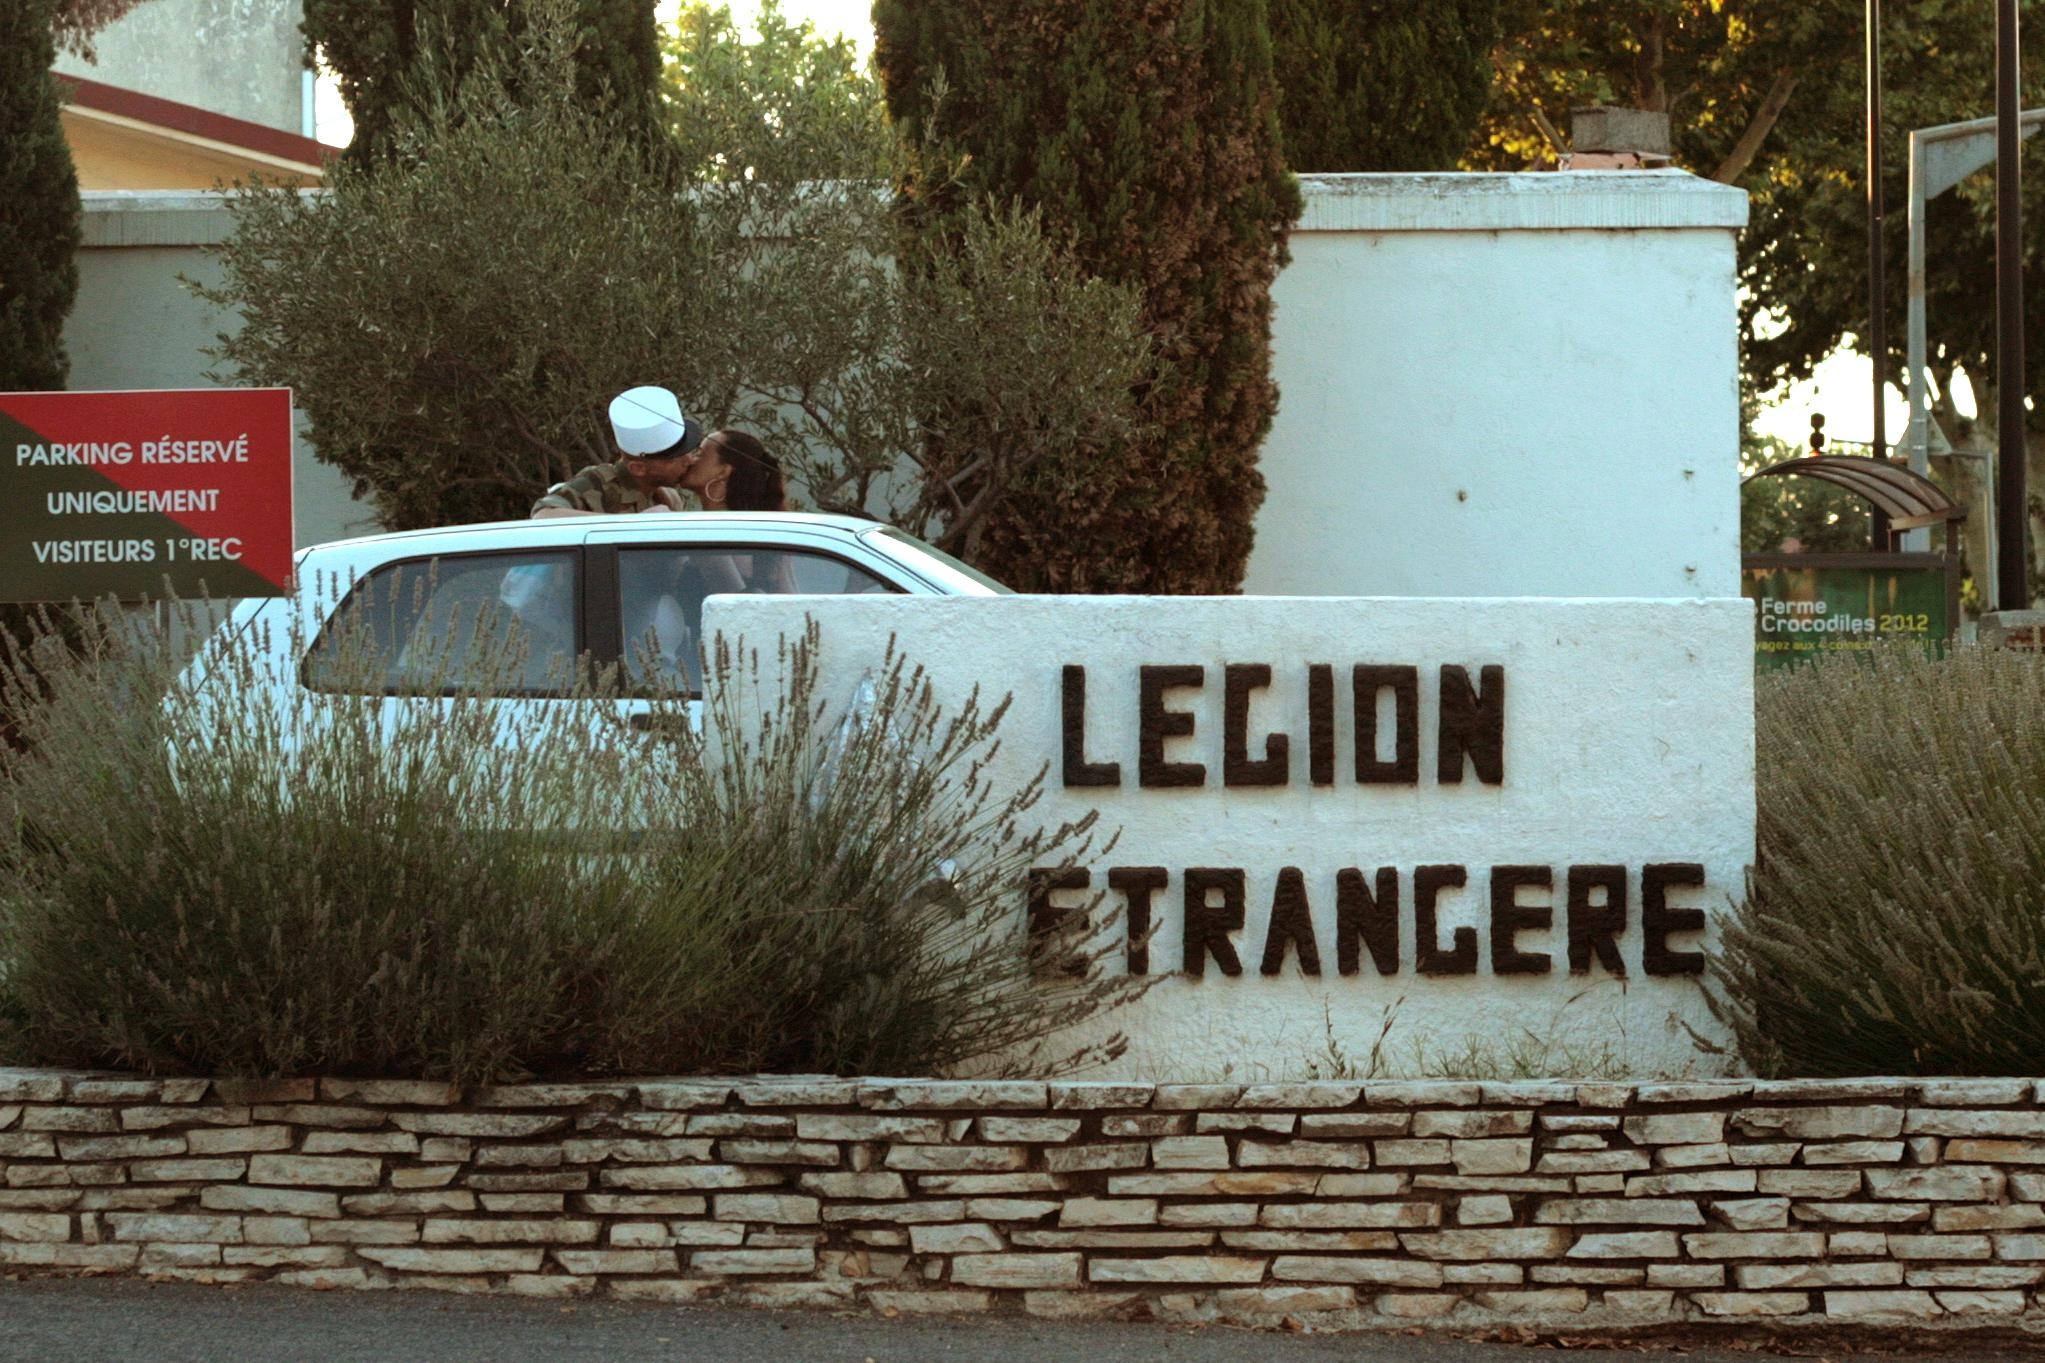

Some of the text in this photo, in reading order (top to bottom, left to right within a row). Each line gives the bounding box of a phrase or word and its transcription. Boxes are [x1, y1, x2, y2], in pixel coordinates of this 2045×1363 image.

[16, 433, 248, 466] PARKING RÉSERVÉ
[47, 489, 219, 514] UNIQUEMENT
[32, 539, 155, 563] VISITEURS
[1761, 597, 1827, 615] Ferme
[1761, 614, 1875, 633] Crocodiles
[1879, 614, 1929, 632] 2012
[1062, 664, 1504, 788] LEGION
[1027, 862, 1705, 977] ETRANGERE
